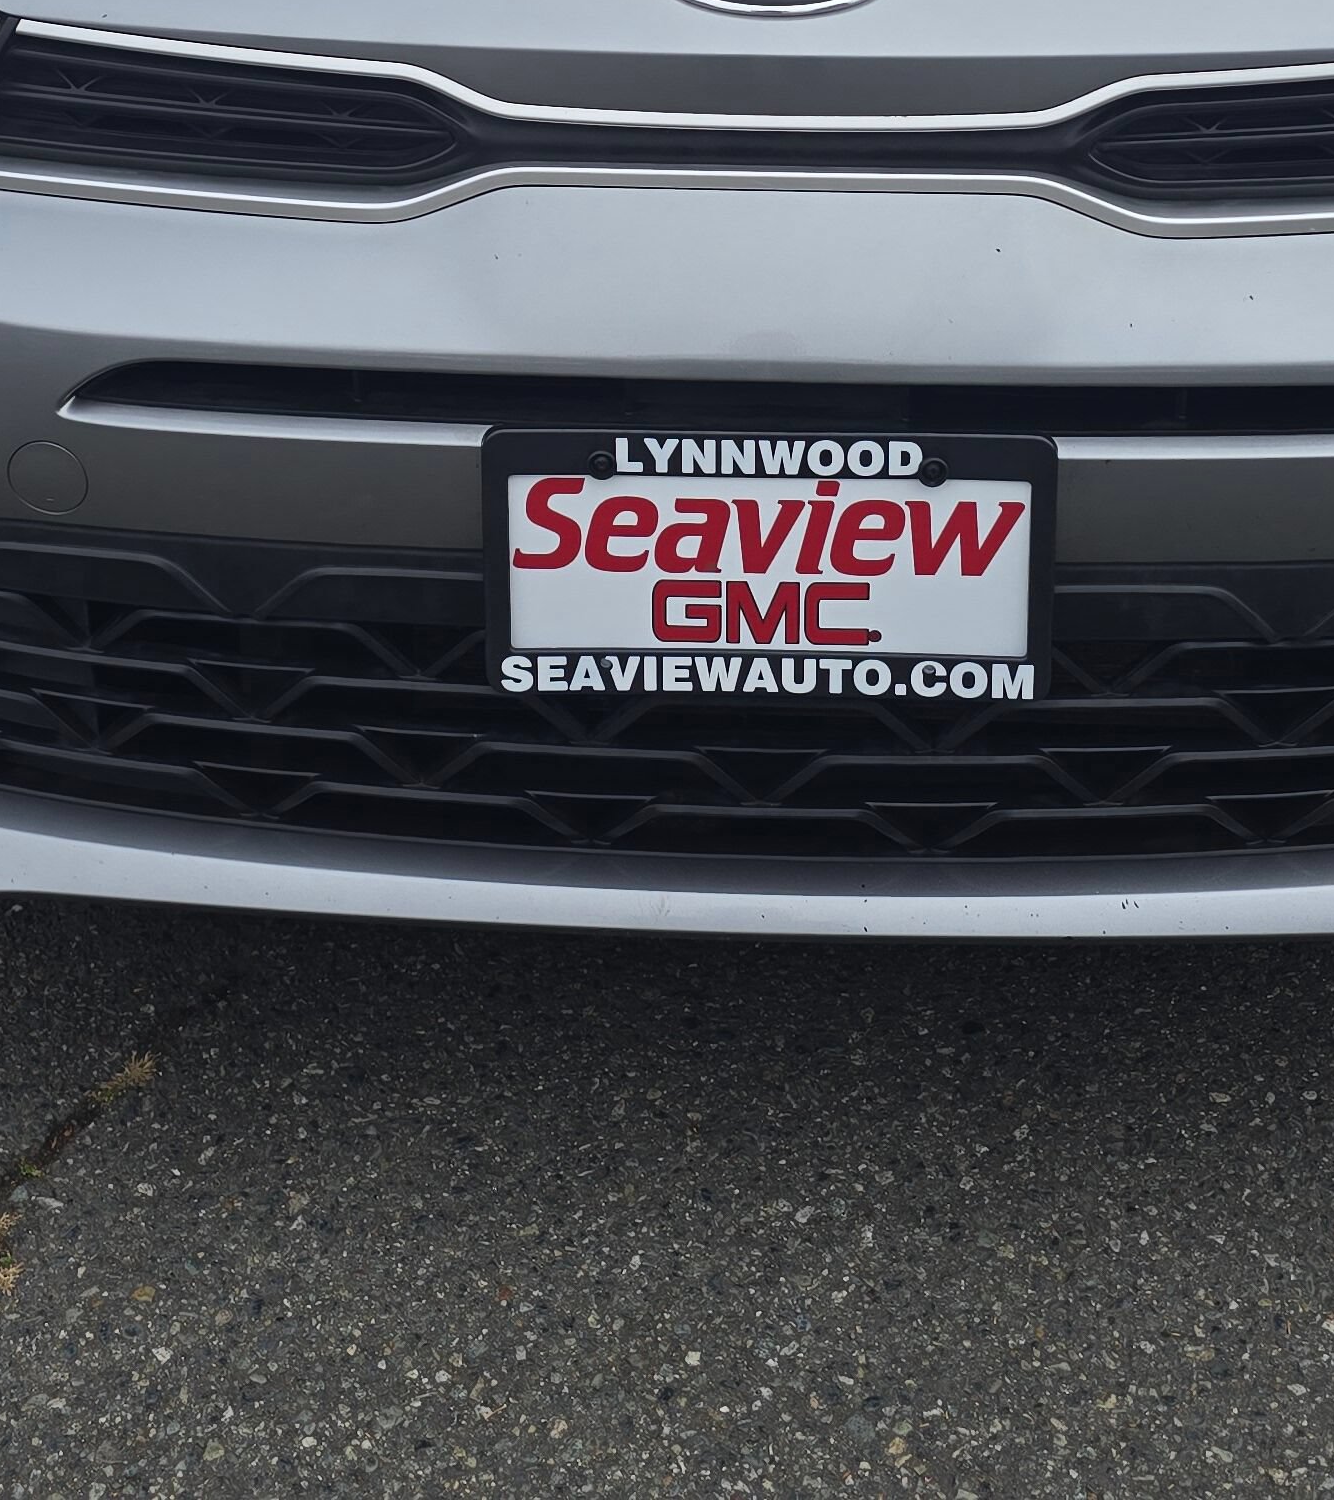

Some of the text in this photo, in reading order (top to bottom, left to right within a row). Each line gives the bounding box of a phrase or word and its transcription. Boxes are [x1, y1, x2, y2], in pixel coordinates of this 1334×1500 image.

[615, 437, 923, 477] LYNNWOOD
[512, 477, 1026, 577] Seaview
[651, 579, 871, 646] GMC
[500, 654, 1035, 700] SEAVIEWAUTO.COM
